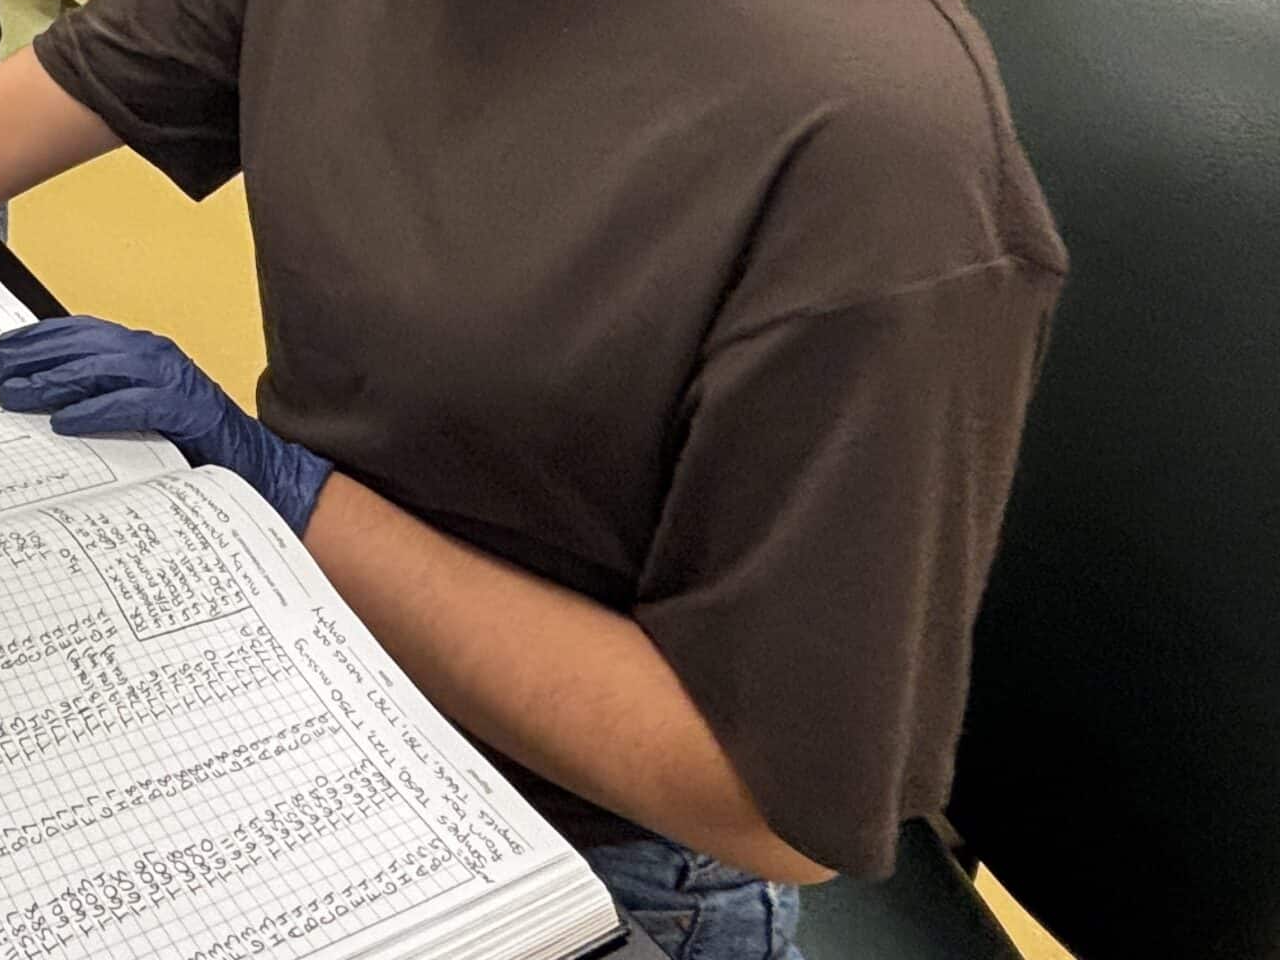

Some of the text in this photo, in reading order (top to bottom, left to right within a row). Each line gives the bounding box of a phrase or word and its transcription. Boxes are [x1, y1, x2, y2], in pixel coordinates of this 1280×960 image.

[130, 606, 148, 632] PCR
[203, 650, 240, 697] T770
[237, 646, 266, 688] T772
[294, 638, 332, 686] missing
[136, 680, 166, 720] T745
[160, 664, 196, 710] T747
[331, 689, 364, 730] T750
[10, 716, 36, 761] T713
[315, 776, 354, 824] T660
[349, 767, 385, 810] T662
[265, 809, 297, 851] T656
[291, 793, 326, 836] T658
[248, 816, 280, 860] T649
[134, 860, 165, 908] T606
[143, 850, 181, 900] T607
[77, 878, 113, 931] T603
